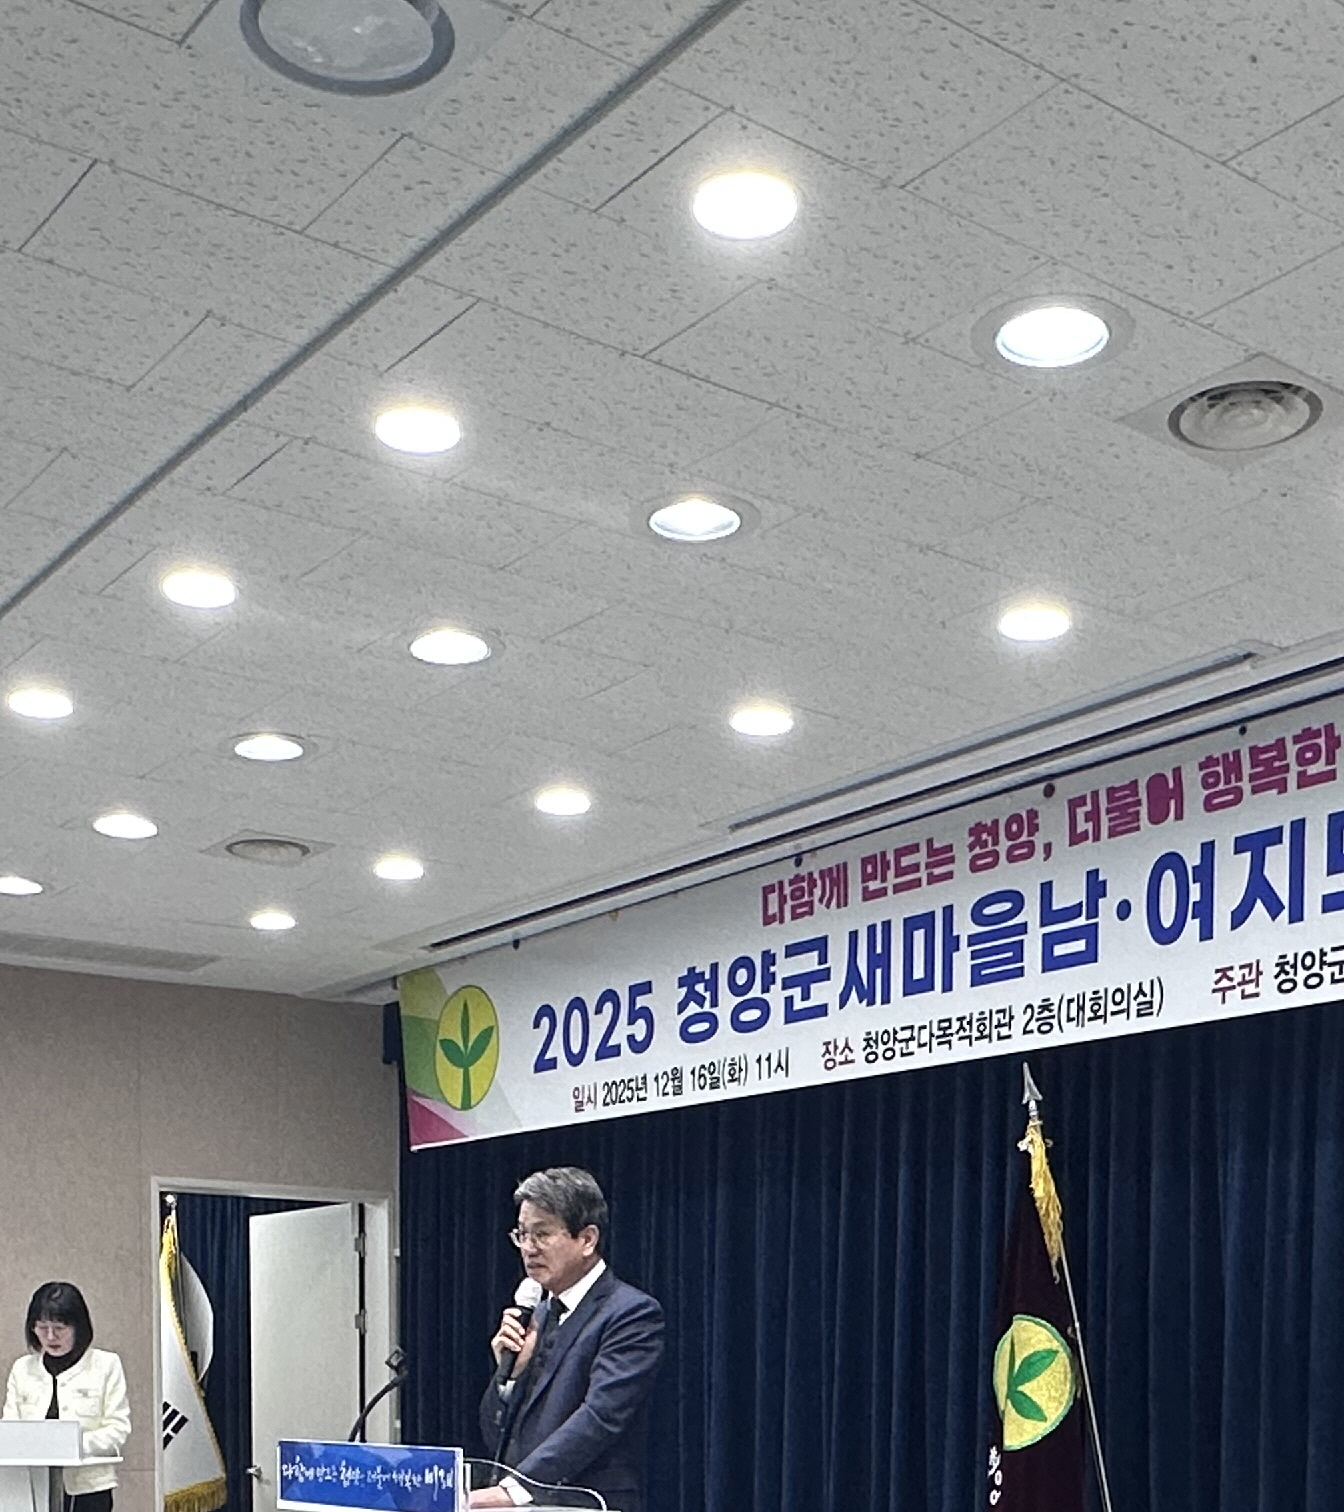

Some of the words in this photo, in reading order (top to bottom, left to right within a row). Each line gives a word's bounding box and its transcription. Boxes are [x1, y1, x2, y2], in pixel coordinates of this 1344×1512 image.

[761, 862, 849, 926] 다함께
[859, 839, 956, 904] 만드는
[967, 807, 1052, 873] 청양,
[1067, 764, 1185, 847] 더불어
[1199, 722, 1342, 814] 행복한
[532, 979, 655, 1074] 2025
[571, 1084, 598, 1112] 일시
[601, 1075, 649, 1108] 2025년
[654, 1065, 685, 1099] 12월
[689, 1056, 750, 1093] 16일(화)
[755, 1046, 791, 1082] 11시
[820, 1037, 855, 1071] 장소
[862, 1006, 1015, 1065] 청양군다목적회관
[1021, 977, 1165, 1037] 2층(대회의실)
[1211, 961, 1263, 1002] 주관
